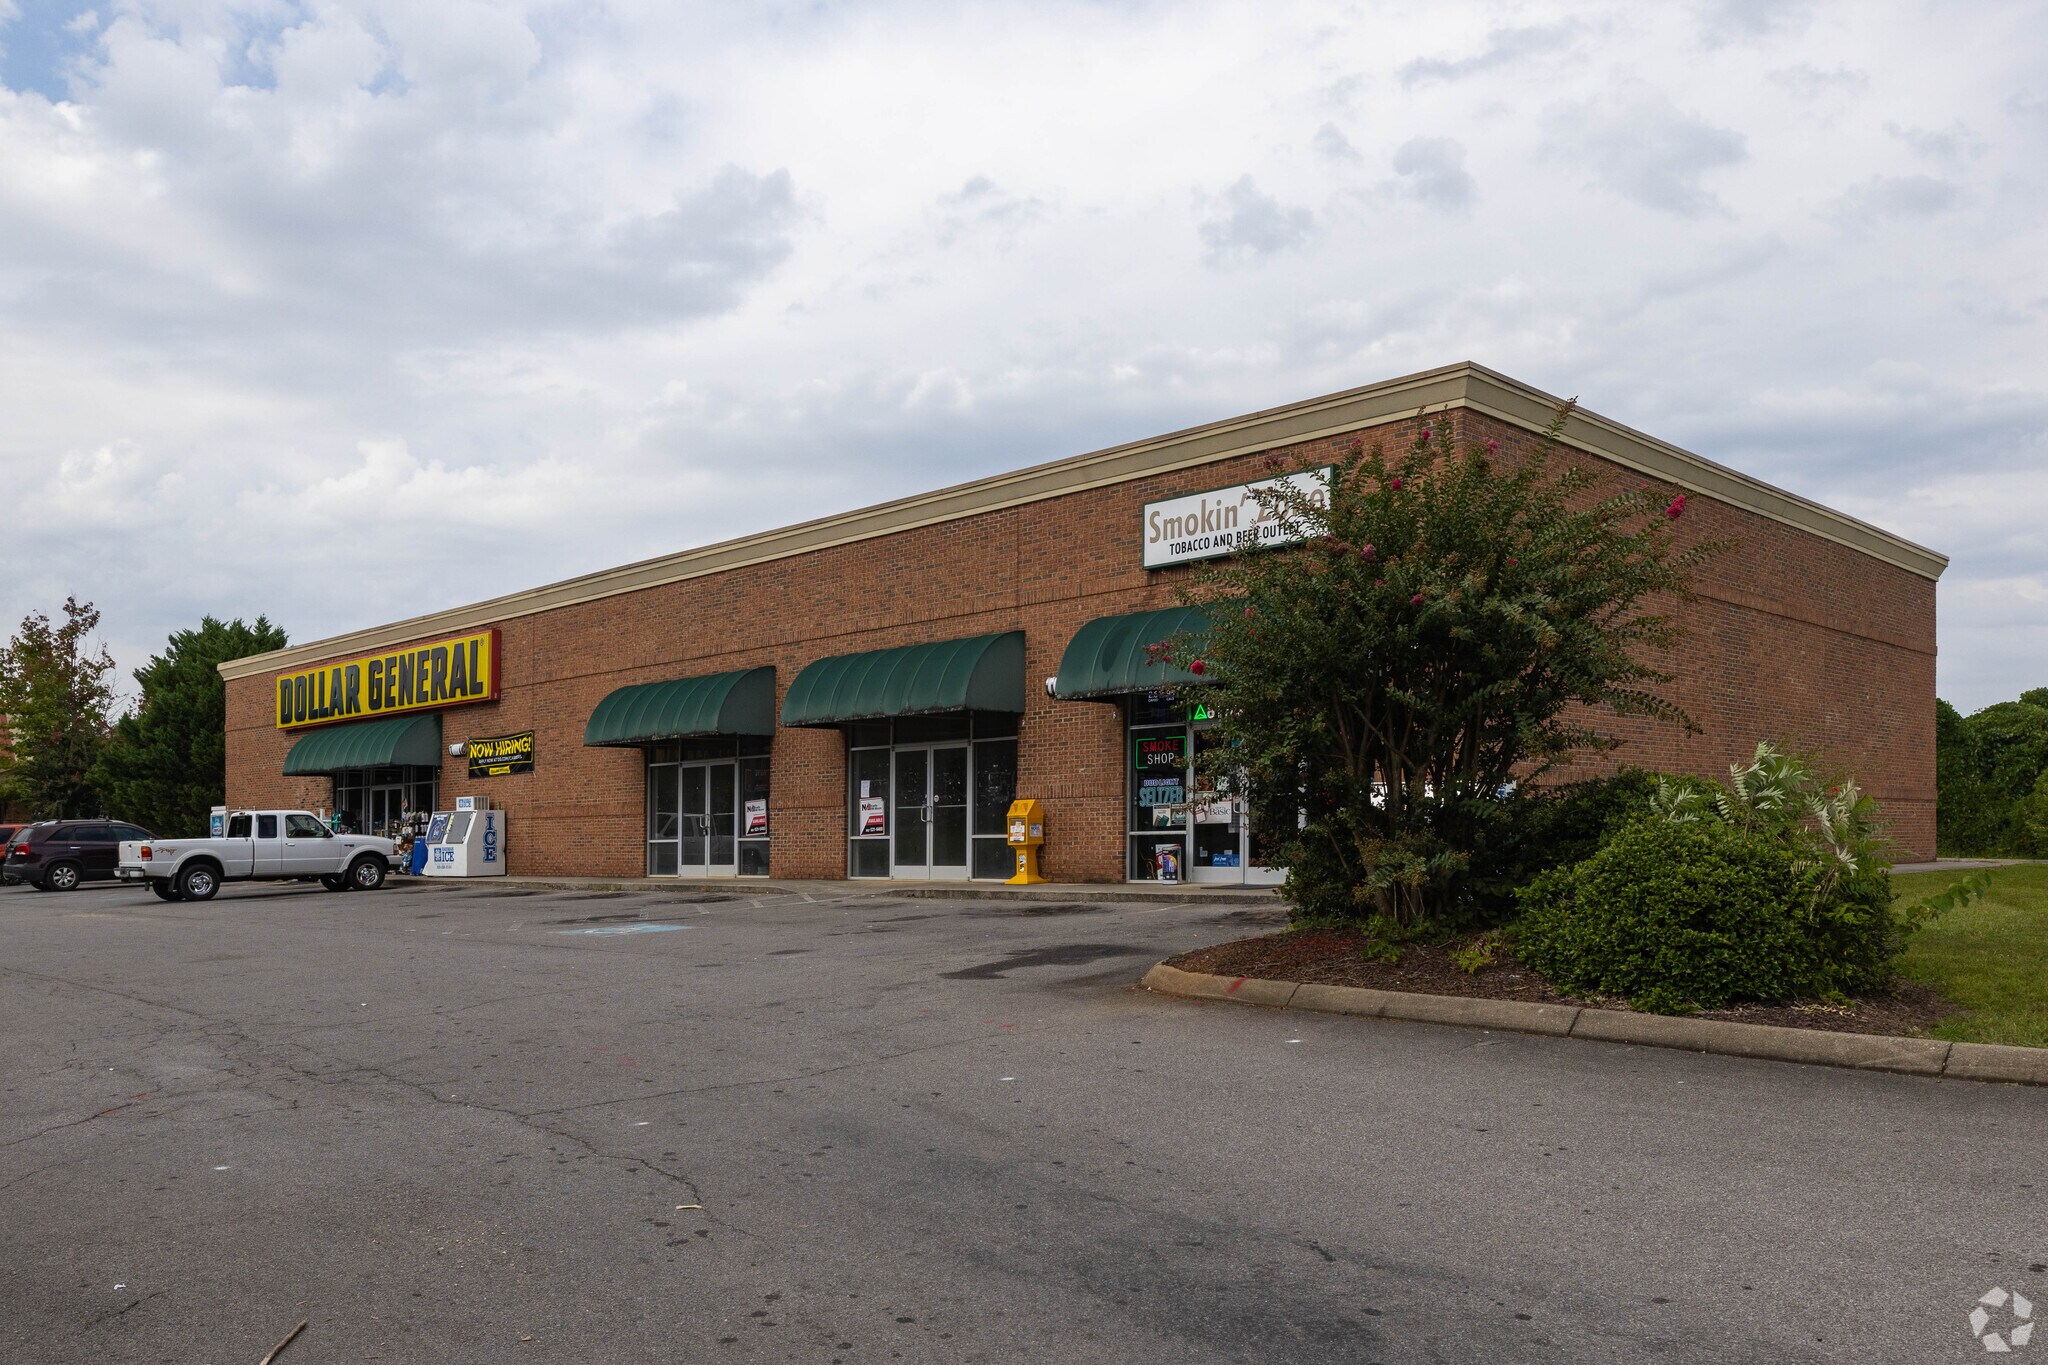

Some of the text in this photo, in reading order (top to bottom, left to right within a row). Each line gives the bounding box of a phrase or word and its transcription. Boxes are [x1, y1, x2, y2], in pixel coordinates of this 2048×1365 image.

[1149, 492, 1248, 544] Smokin'
[1169, 534, 1210, 556] TOBACCO
[1213, 532, 1233, 548] AND
[1236, 528, 1259, 544] BEER
[279, 639, 484, 725] DOLLAR GENERAL
[470, 736, 531, 759] NOW HIRING!
[1142, 739, 1179, 752] SMOKE
[1147, 752, 1175, 765] SHOP
[1139, 785, 1184, 808] SELTZER
[1209, 807, 1231, 816] Basic
[482, 812, 498, 864] ICE
[442, 851, 455, 863] ICE
